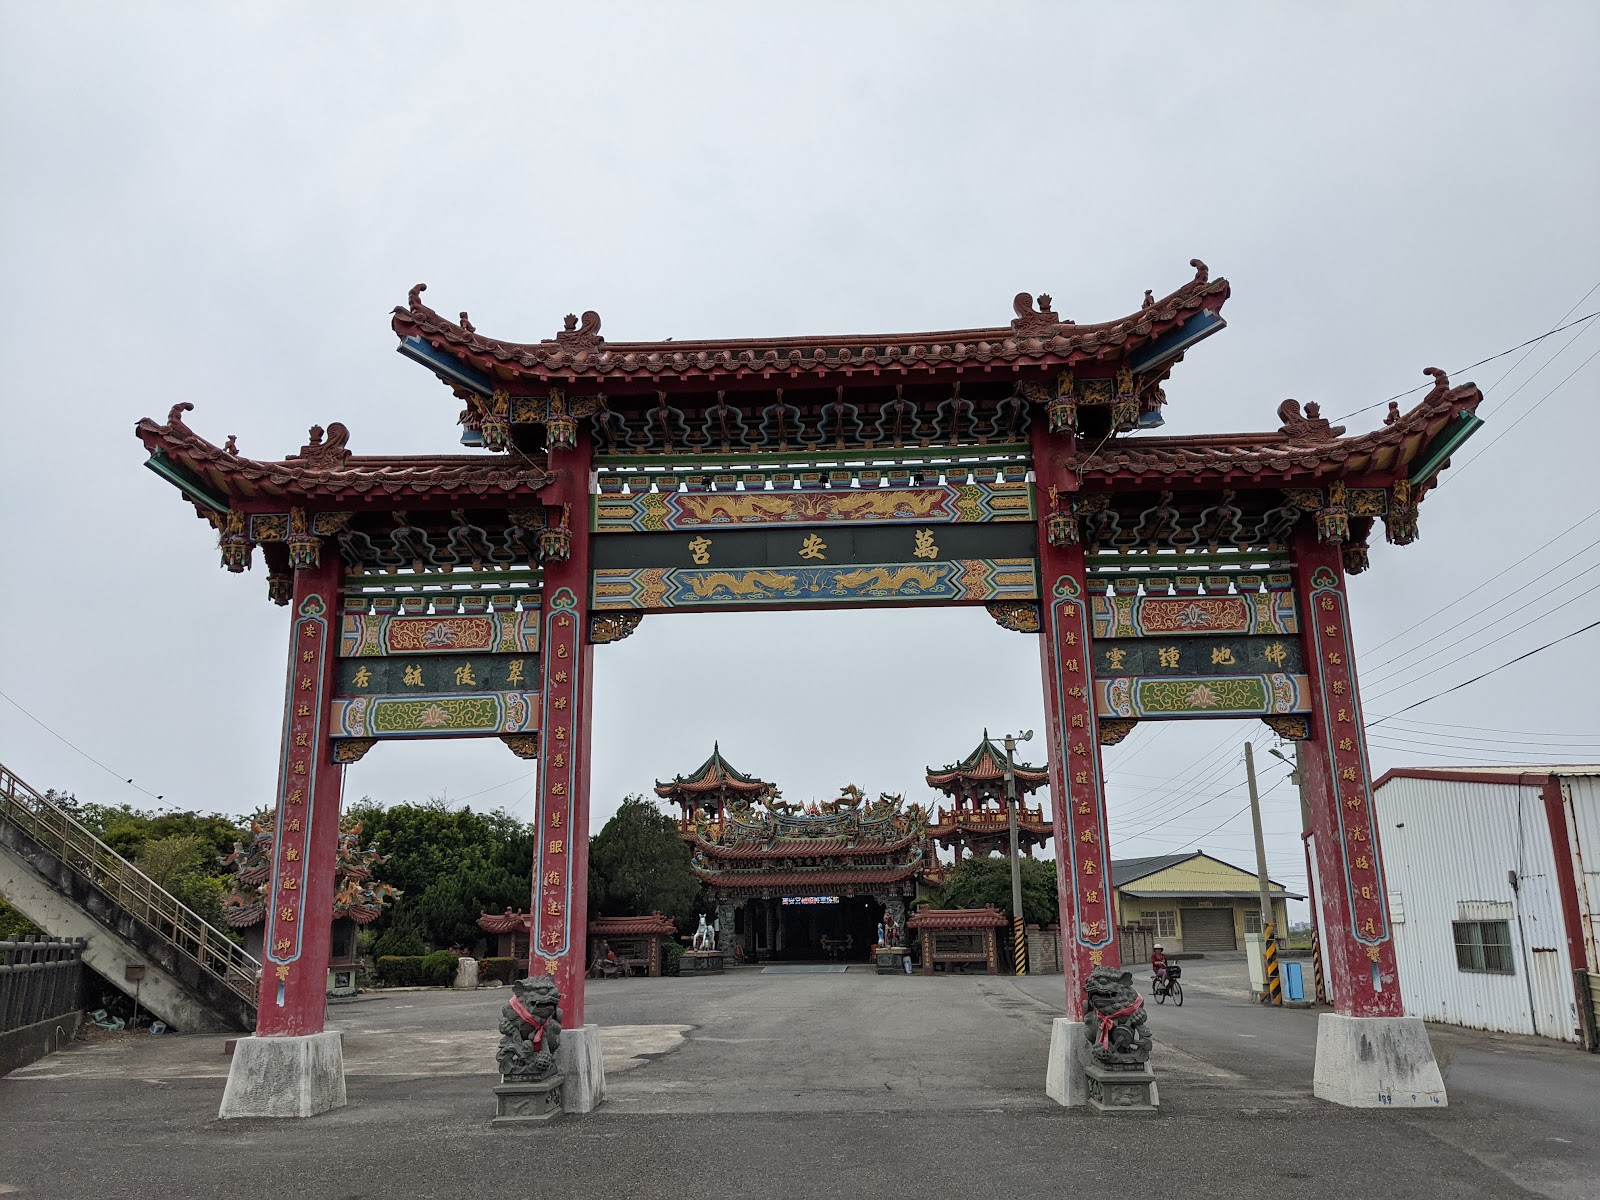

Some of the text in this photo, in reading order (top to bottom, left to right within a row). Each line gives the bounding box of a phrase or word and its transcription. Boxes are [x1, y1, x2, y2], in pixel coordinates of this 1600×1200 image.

[687, 528, 940, 566] 萬安宮
[351, 659, 525, 688] 翠陵毓秀
